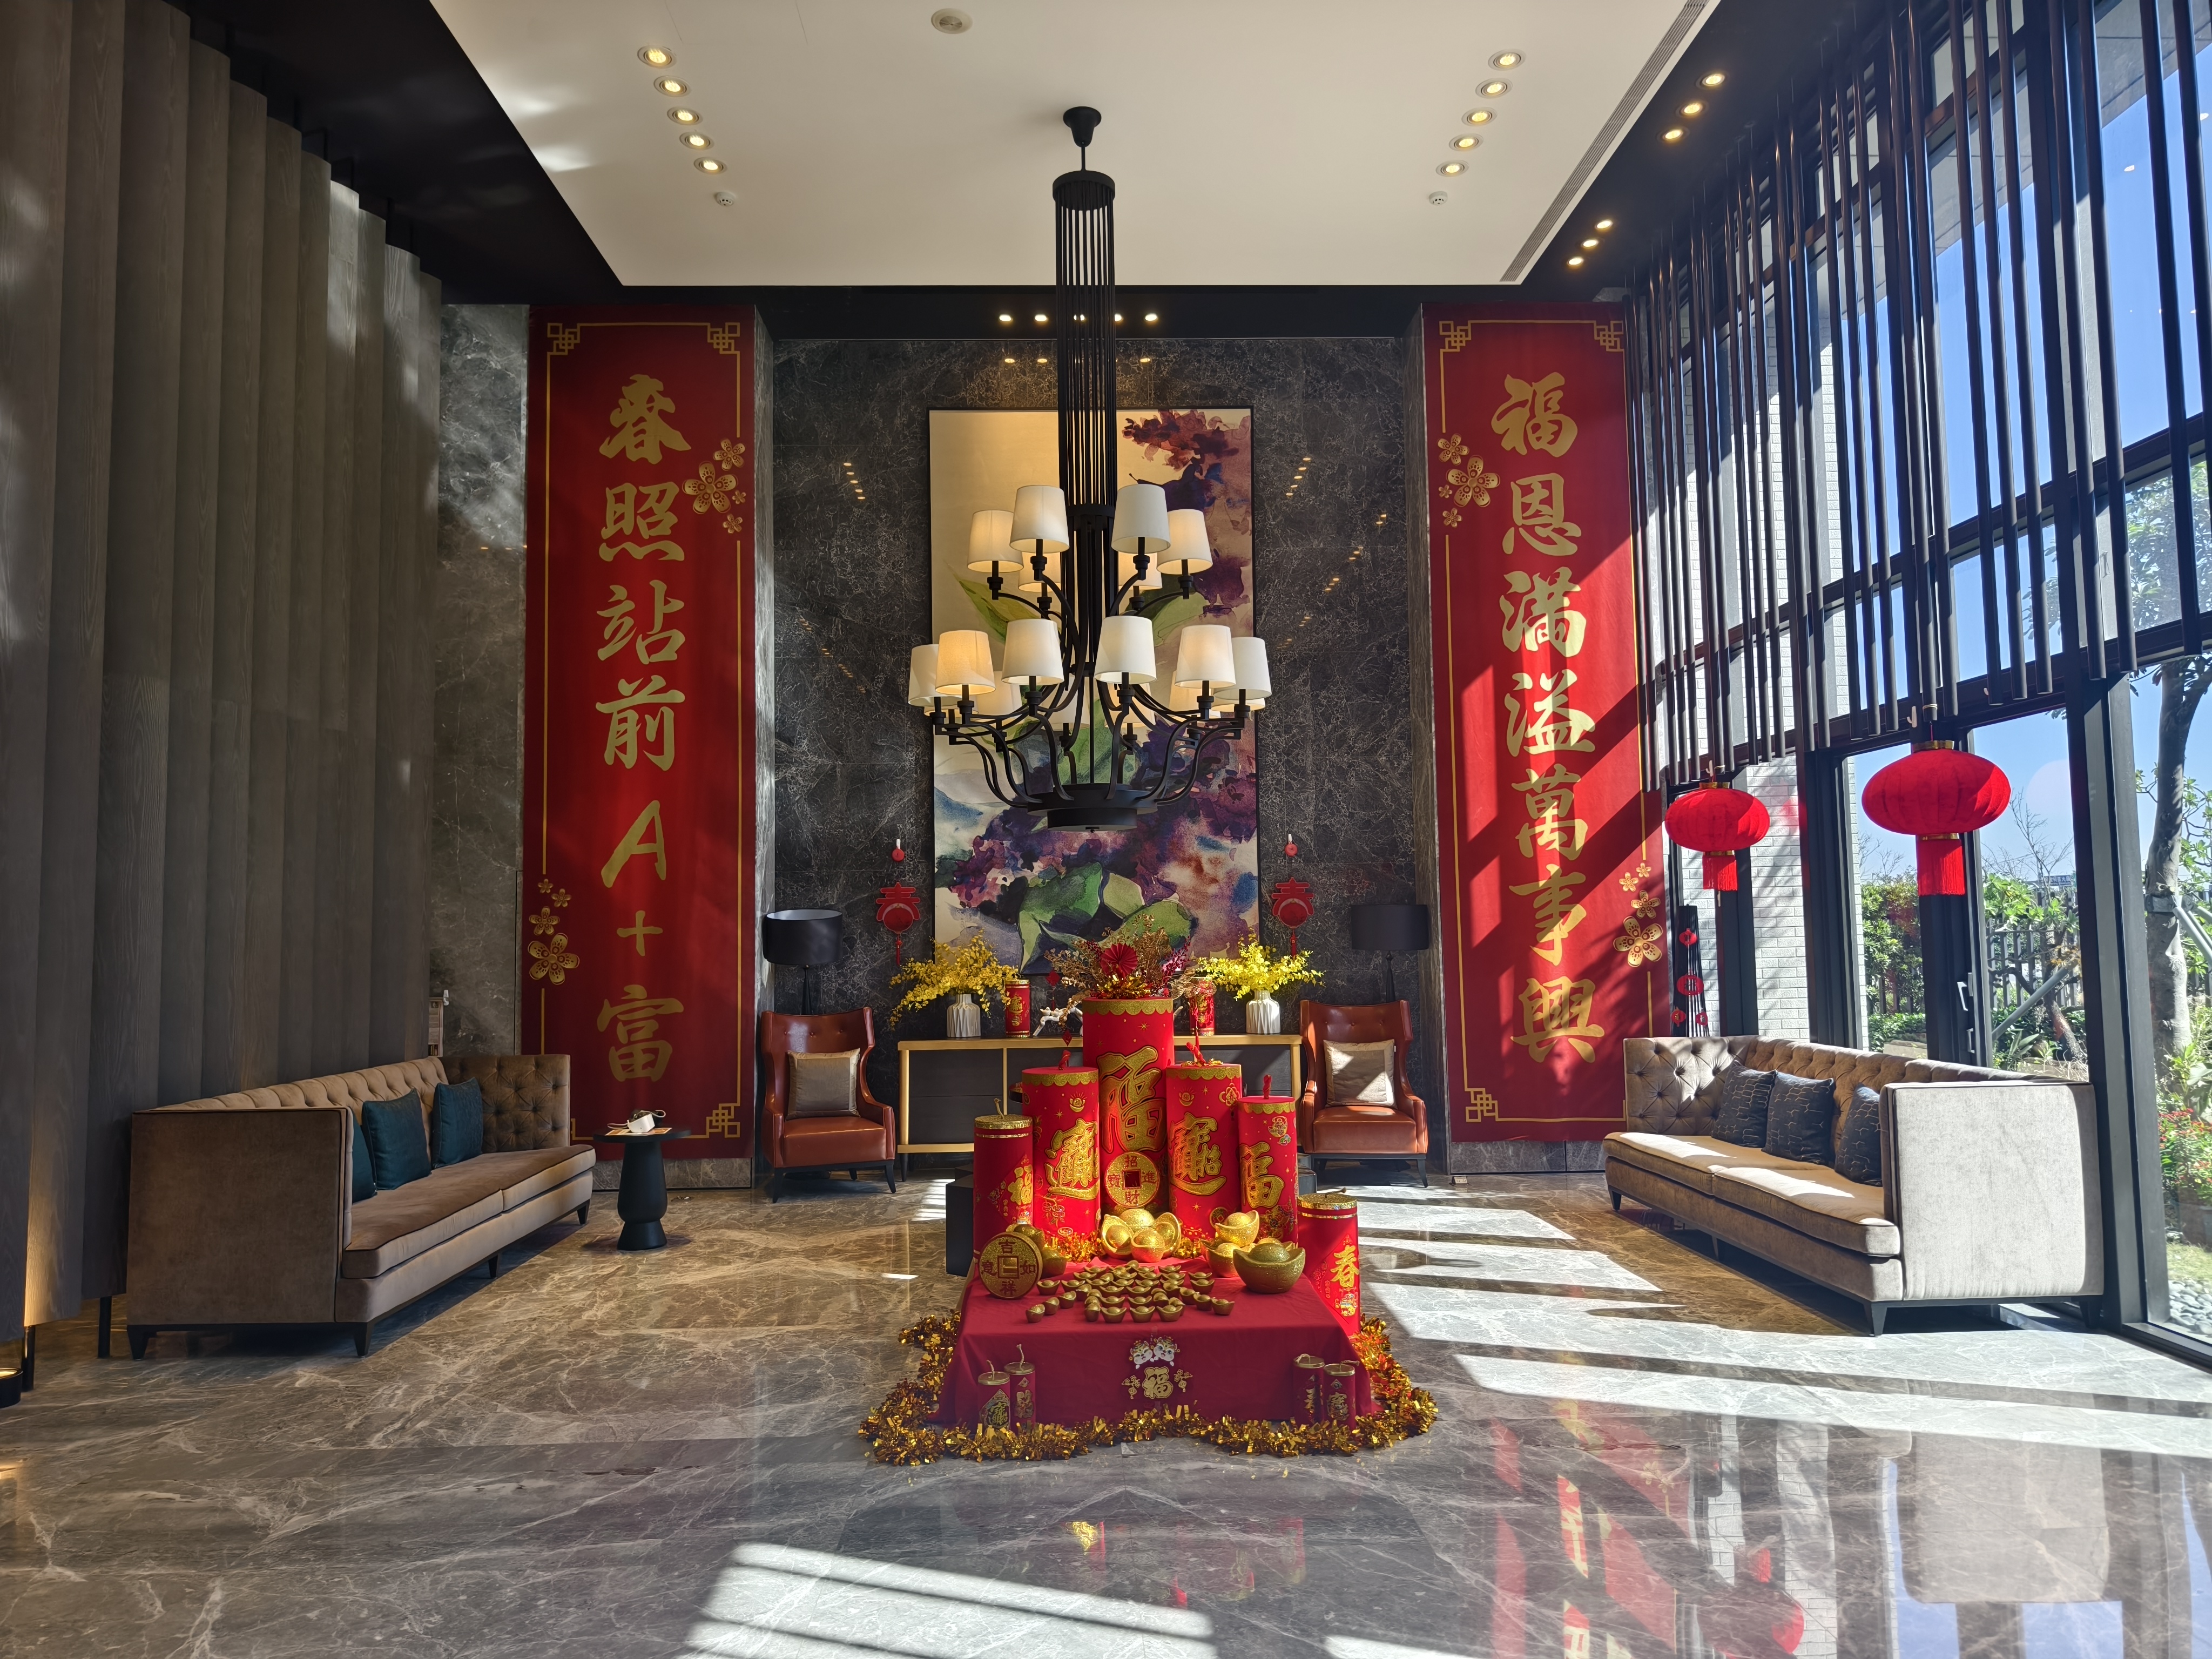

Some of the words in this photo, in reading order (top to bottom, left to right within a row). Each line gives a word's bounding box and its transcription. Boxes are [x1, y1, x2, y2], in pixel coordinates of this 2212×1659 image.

[1491, 372, 1604, 1063] 福恩滿溢萬事興
[1097, 1046, 1167, 1154] 福
[1239, 1142, 1285, 1209] 福
[1330, 1244, 1360, 1288] 春
[1142, 1366, 1174, 1399] 福
